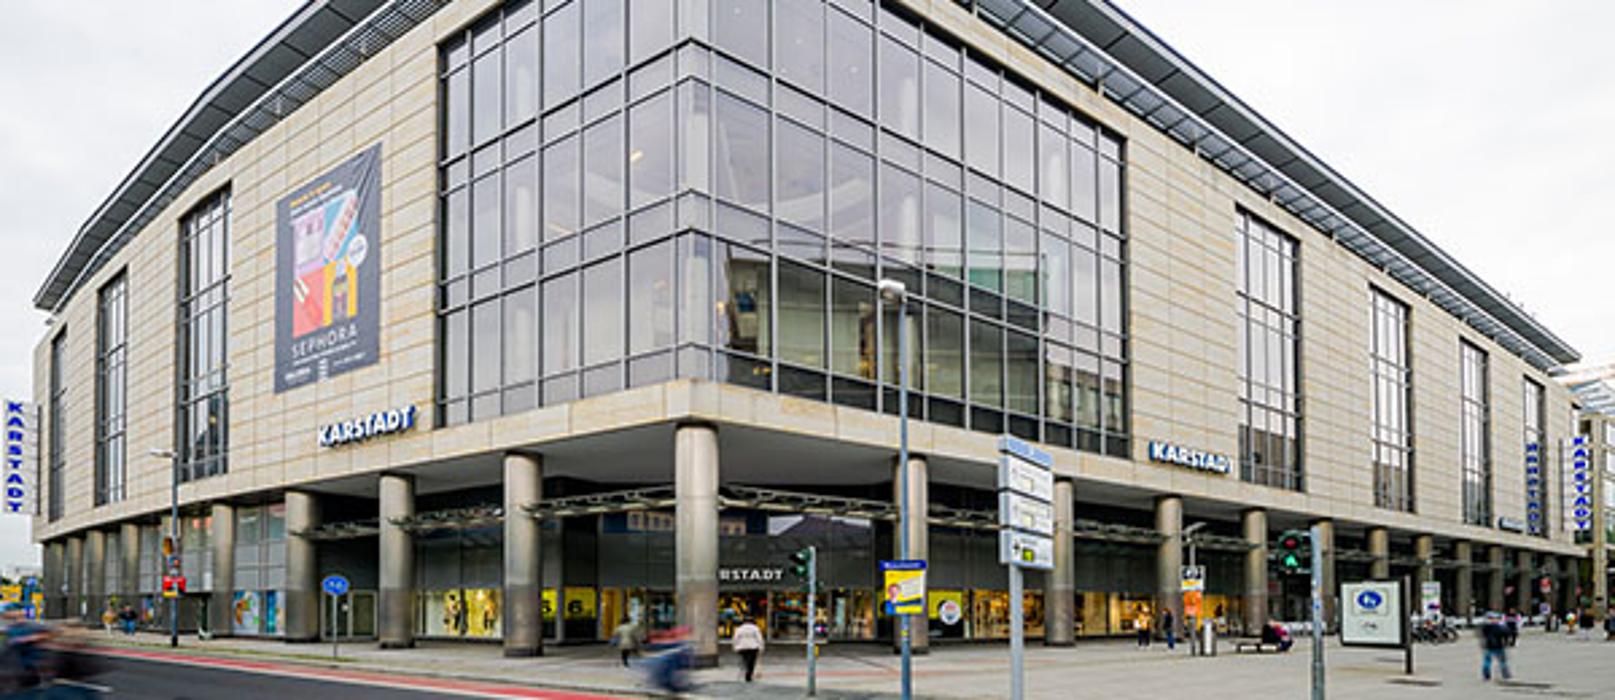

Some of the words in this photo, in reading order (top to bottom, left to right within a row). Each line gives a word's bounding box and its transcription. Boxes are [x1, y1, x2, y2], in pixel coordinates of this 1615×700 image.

[290, 322, 359, 359] SEPHORA
[317, 404, 417, 447] KARSTADT
[7, 402, 24, 512] KARSTADT
[718, 568, 784, 580] RSTADT
